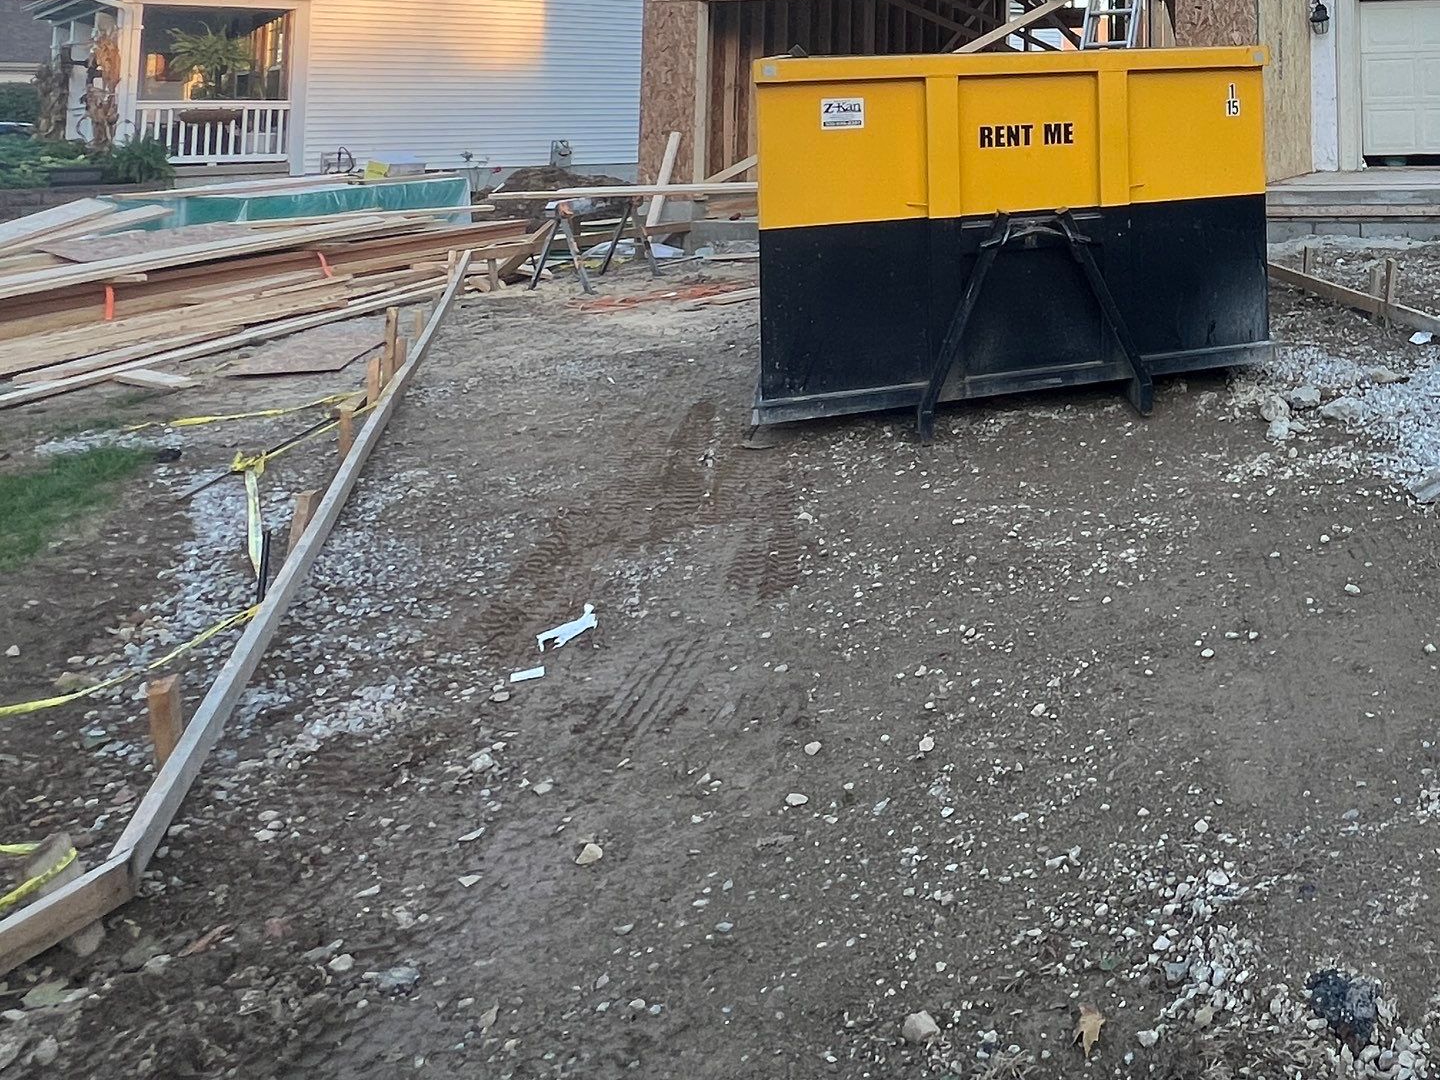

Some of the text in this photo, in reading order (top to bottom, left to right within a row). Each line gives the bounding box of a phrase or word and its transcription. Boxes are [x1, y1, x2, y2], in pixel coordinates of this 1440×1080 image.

[1229, 84, 1235, 99] 1
[1227, 100, 1239, 115] 15
[979, 122, 1074, 148] RENT ME
